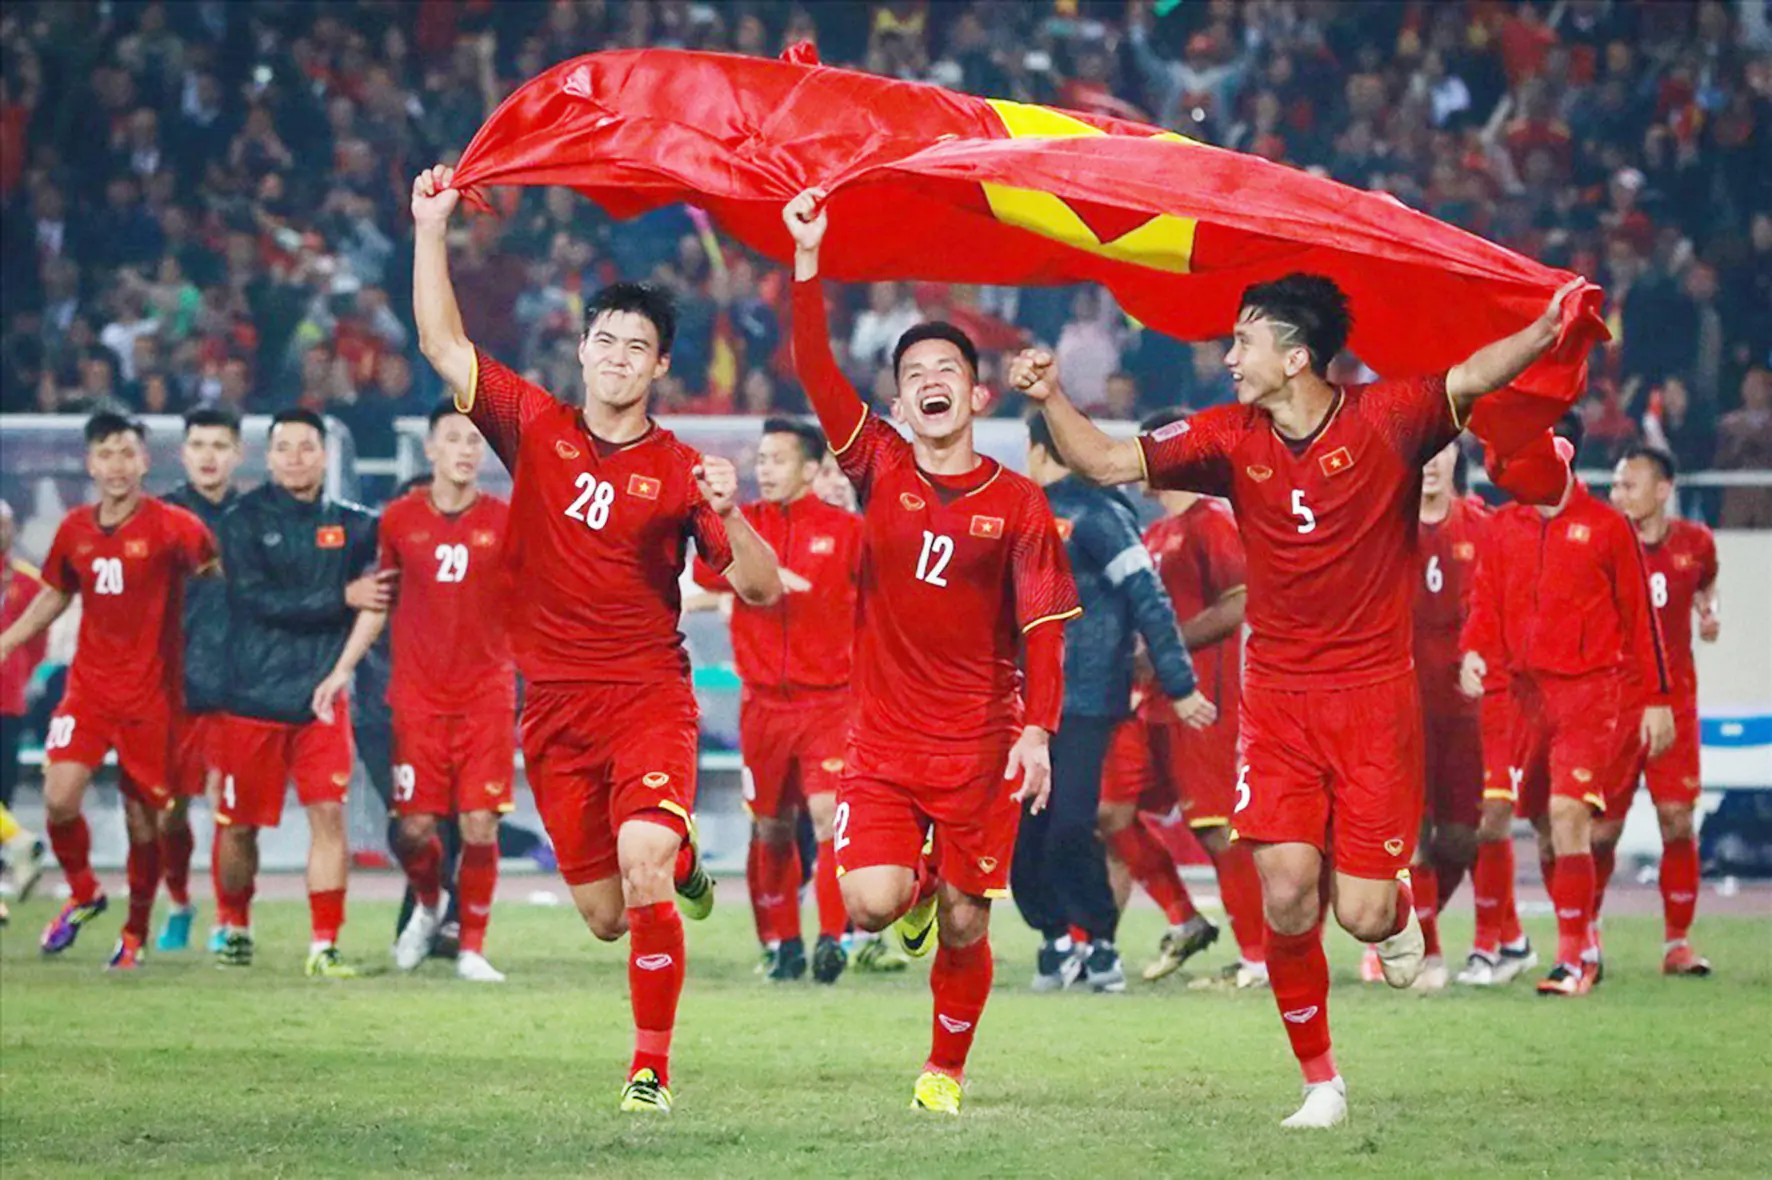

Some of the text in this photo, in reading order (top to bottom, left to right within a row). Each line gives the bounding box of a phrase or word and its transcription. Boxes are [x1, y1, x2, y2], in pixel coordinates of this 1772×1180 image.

[564, 471, 615, 530] 28
[1291, 489, 1316, 534] 5
[91, 557, 124, 595] 20
[434, 543, 469, 583] 29
[915, 530, 954, 587] 12
[1426, 555, 1443, 593] 6
